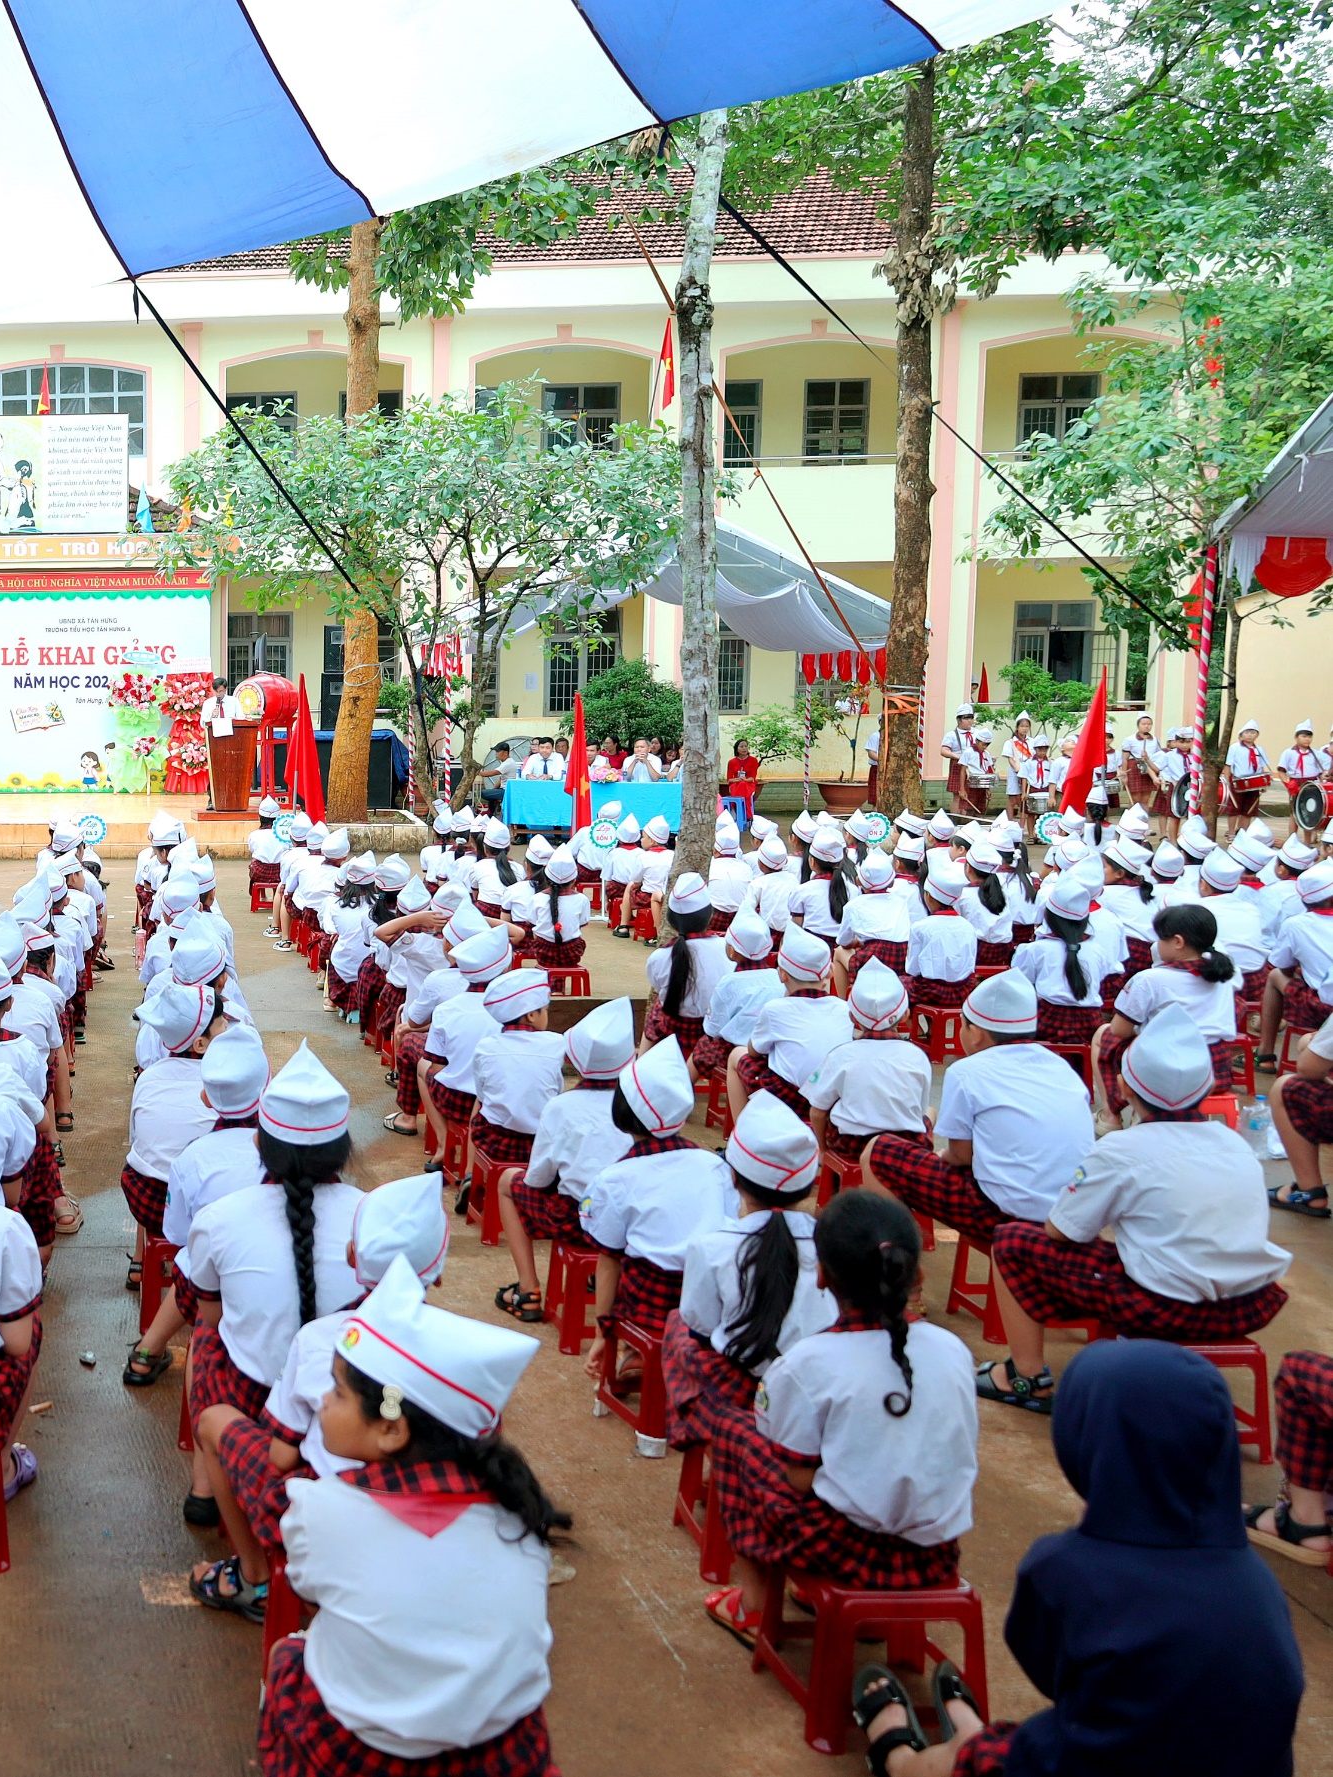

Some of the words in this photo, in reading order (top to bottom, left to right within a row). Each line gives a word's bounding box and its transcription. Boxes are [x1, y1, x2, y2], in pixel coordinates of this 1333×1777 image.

[92, 424, 105, 432] Việt
[95, 446, 107, 454] Việt
[2, 538, 40, 557] TỐT
[60, 538, 100, 556] TRÒ
[7, 576, 25, 590] HỘI
[27, 576, 48, 588] CHỦ
[50, 576, 82, 587] NGHĨA
[83, 576, 106, 589] VIỆT
[108, 578, 130, 587] NAM
[132, 575, 162, 586] MUÔN
[1, 637, 30, 666] LỄ
[38, 647, 95, 666] KHAI
[13, 673, 45, 689] NĂM
[49, 676, 81, 692] HỌC
[85, 676, 109, 688] 202
